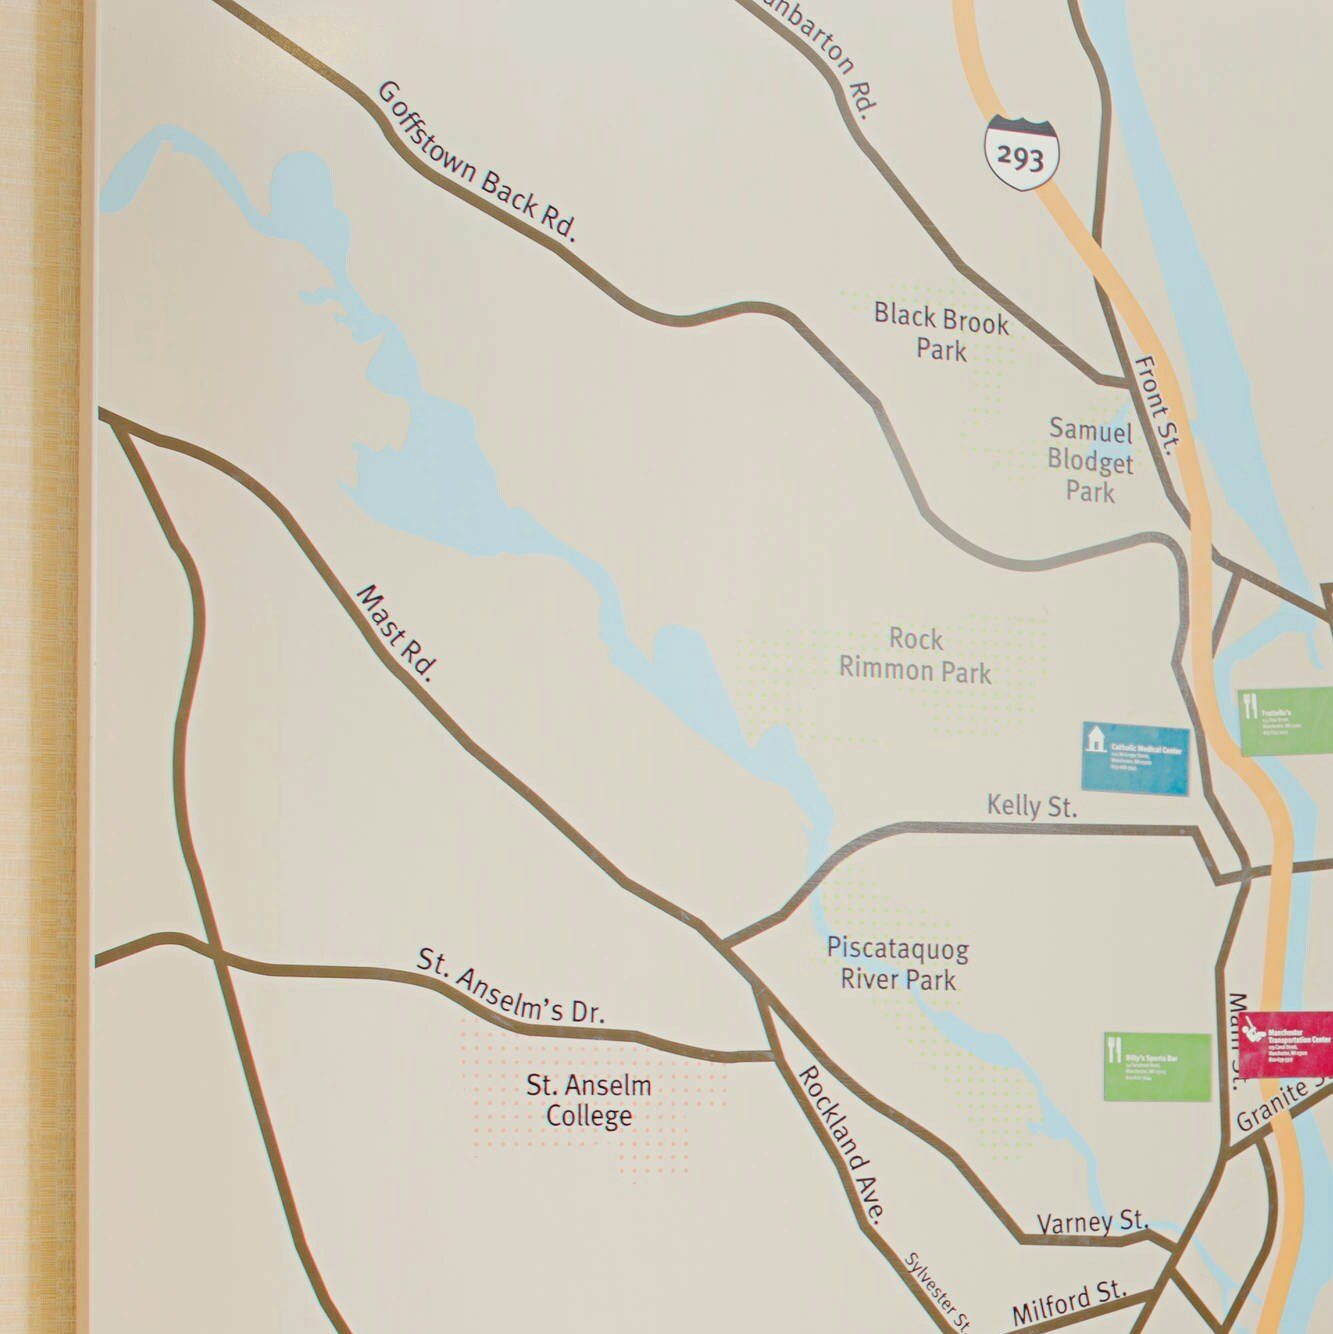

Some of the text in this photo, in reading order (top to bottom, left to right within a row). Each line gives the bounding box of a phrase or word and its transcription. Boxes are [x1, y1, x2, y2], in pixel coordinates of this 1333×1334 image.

[378, 79, 577, 244] Goffstown Back Rd.
[997, 145, 1045, 173] 293
[874, 301, 1010, 337] Black Brook
[916, 337, 968, 363] Park
[1049, 416, 1133, 445] Samuel
[1048, 446, 1135, 478] Blodget
[1066, 479, 1115, 504] Park
[357, 583, 435, 683] Mast Rd.
[987, 793, 1078, 821] Kelly St.
[827, 936, 970, 965] Piscataquog
[840, 968, 957, 991] River Park
[526, 1073, 651, 1097] St. Anselm
[546, 1104, 633, 1132] College
[799, 1065, 885, 1226] Rockland Ave.
